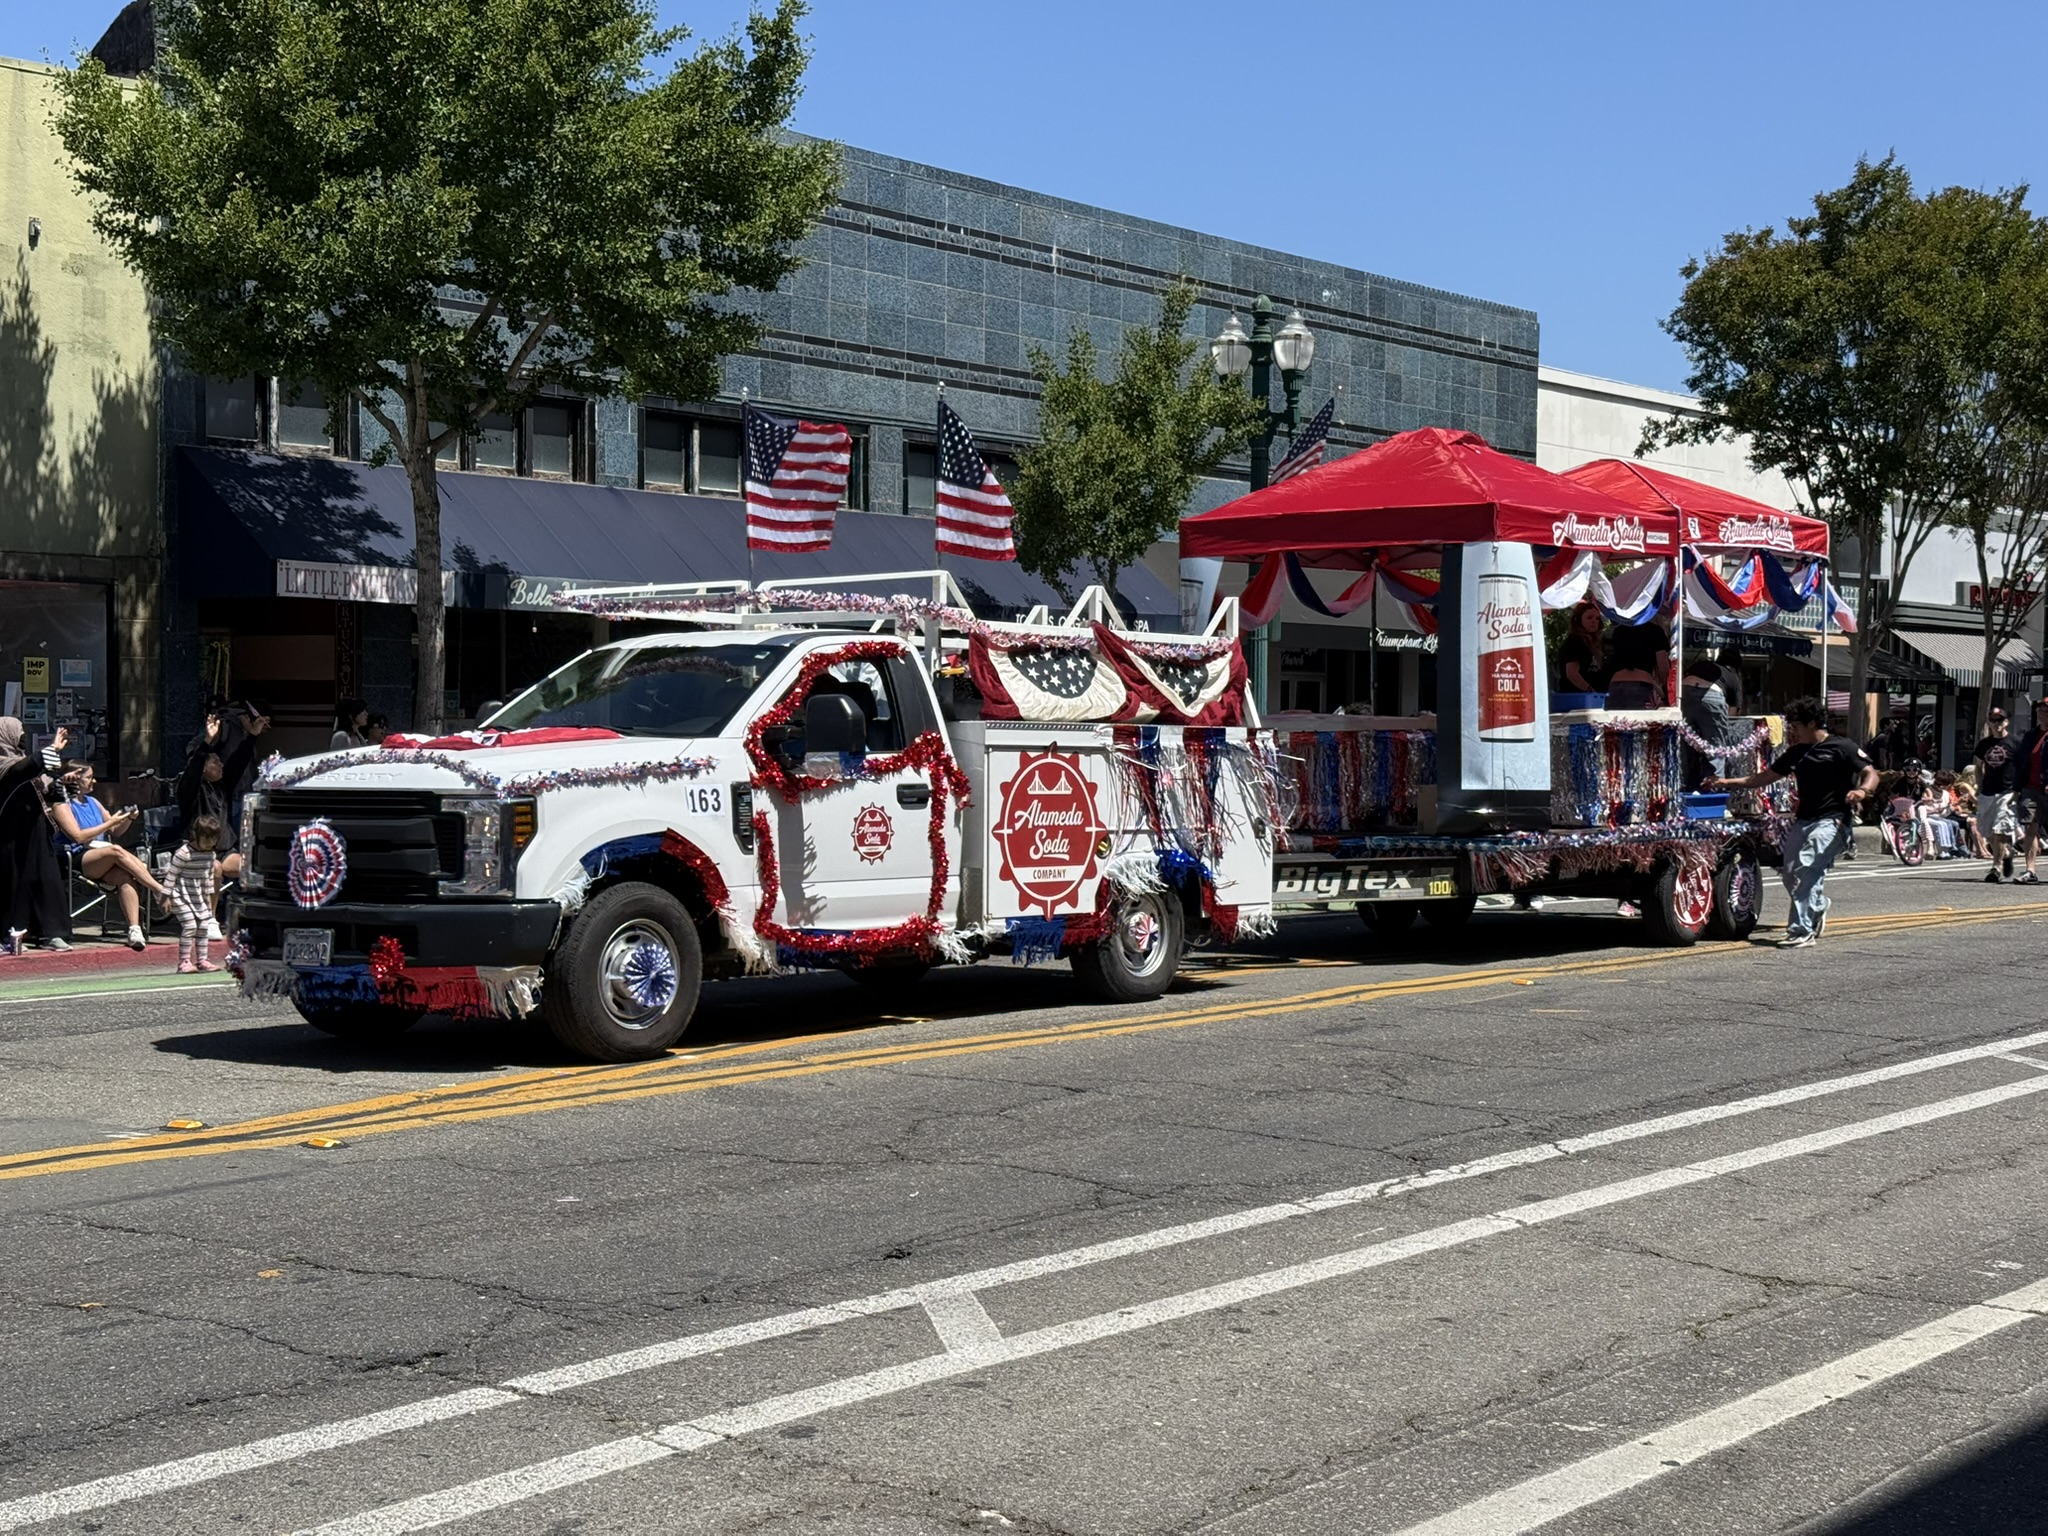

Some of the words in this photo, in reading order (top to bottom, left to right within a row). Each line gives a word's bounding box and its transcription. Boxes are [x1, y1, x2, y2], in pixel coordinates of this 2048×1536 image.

[1552, 512, 1611, 547] Alameda
[1610, 515, 1645, 552] Soda
[285, 567, 339, 596] LITTLE
[510, 578, 553, 606] Bella
[1477, 600, 1530, 625] Alameda
[1133, 619, 1150, 632] SPA
[1487, 617, 1525, 640] Soda
[1371, 627, 1423, 651] Triumphant
[27, 660, 45, 669] IMP
[1498, 679, 1520, 692] COLA
[344, 772, 402, 781] DUTY
[689, 788, 722, 813] 163
[1014, 799, 1084, 831] Alameda
[1029, 828, 1071, 861] Soda
[1032, 868, 1067, 880] COMPANY
